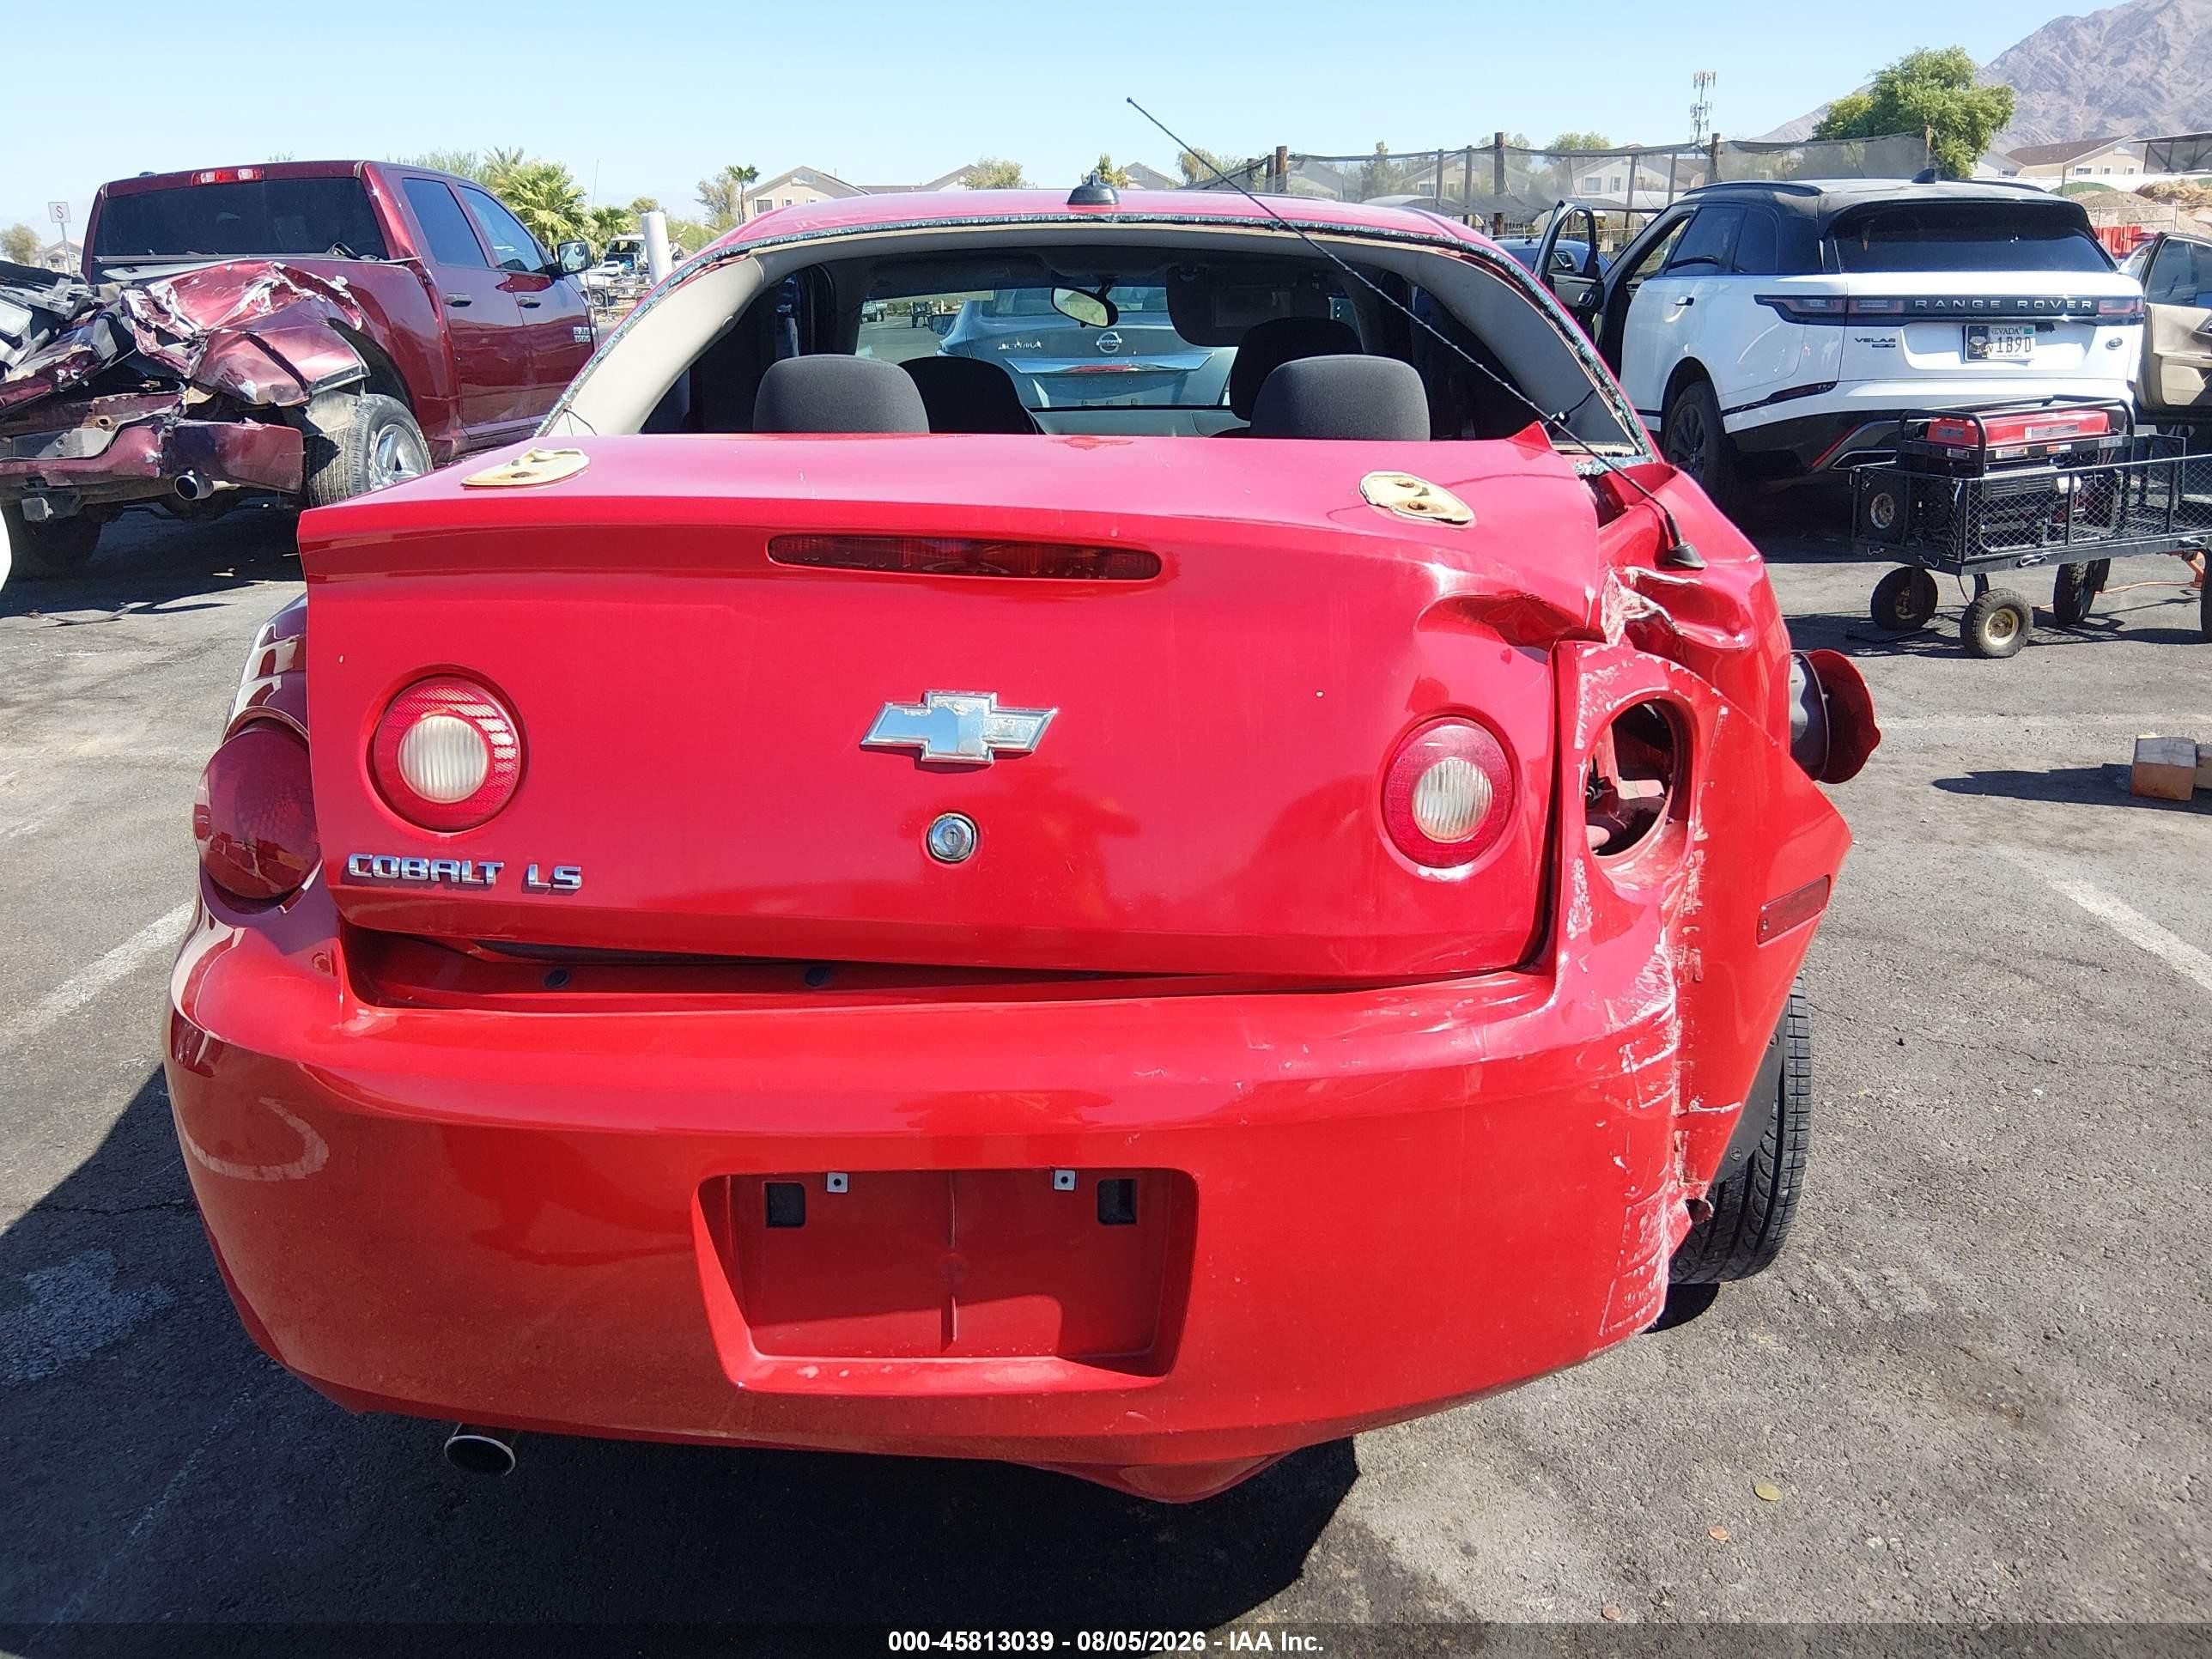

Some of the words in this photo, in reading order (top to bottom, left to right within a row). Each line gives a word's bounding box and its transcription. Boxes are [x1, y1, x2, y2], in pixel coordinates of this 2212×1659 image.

[56, 205, 64, 219] S
[1915, 300, 2001, 309] RANGE
[2019, 300, 2093, 309] ROVER
[348, 853, 505, 885] COBALT
[527, 864, 582, 890] LS
